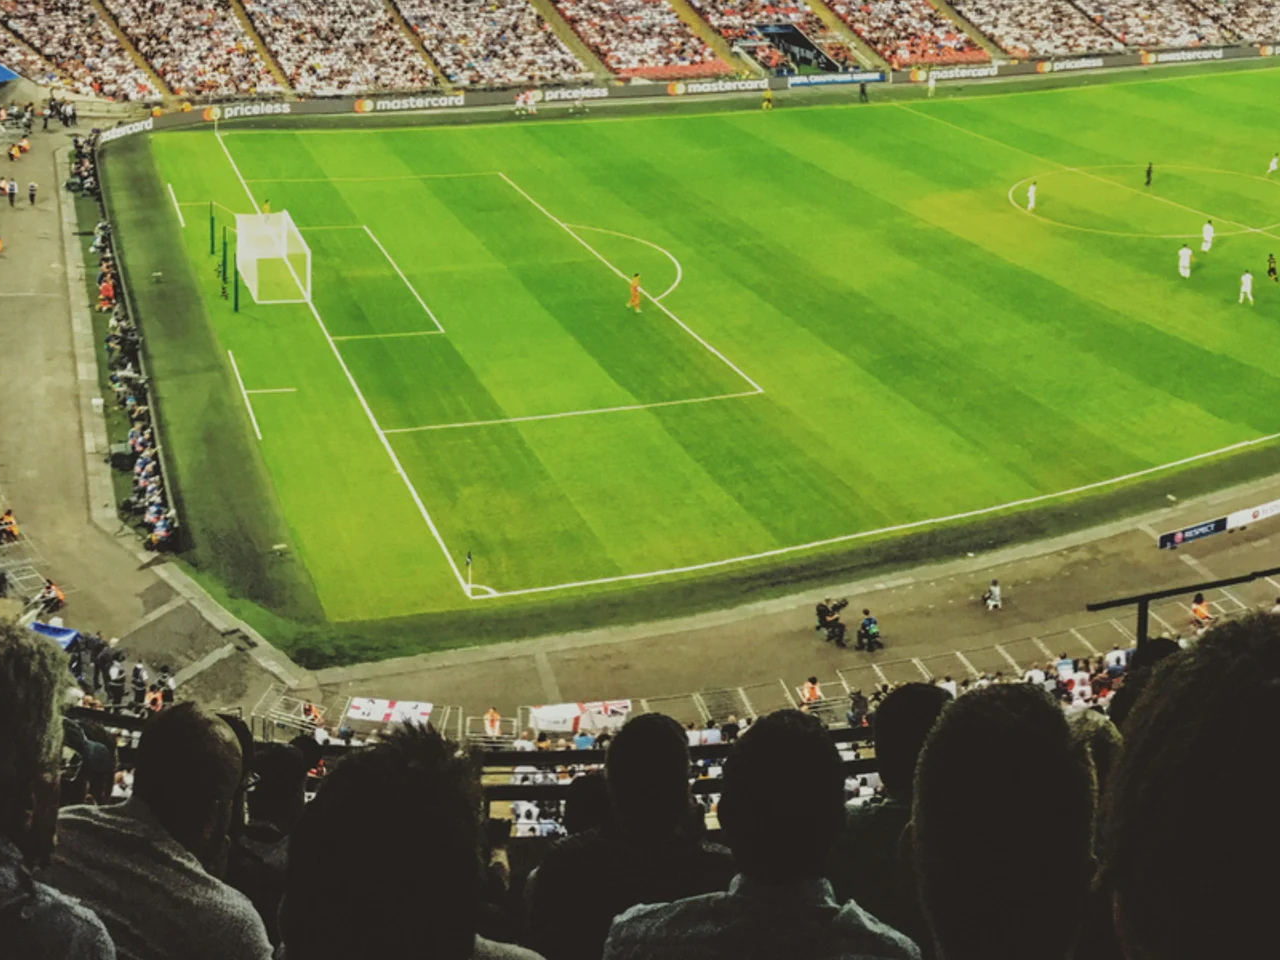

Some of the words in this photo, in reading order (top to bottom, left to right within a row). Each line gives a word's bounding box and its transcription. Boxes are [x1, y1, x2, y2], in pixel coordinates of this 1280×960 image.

[1157, 49, 1223, 61] mastercard
[1053, 58, 1103, 71] priceless
[929, 65, 998, 80] mastercard
[687, 78, 768, 93] mastercard
[544, 87, 609, 101] priceless
[376, 93, 465, 110] mastercard
[224, 103, 291, 117] priceless
[1184, 523, 1215, 537] RESPECT
